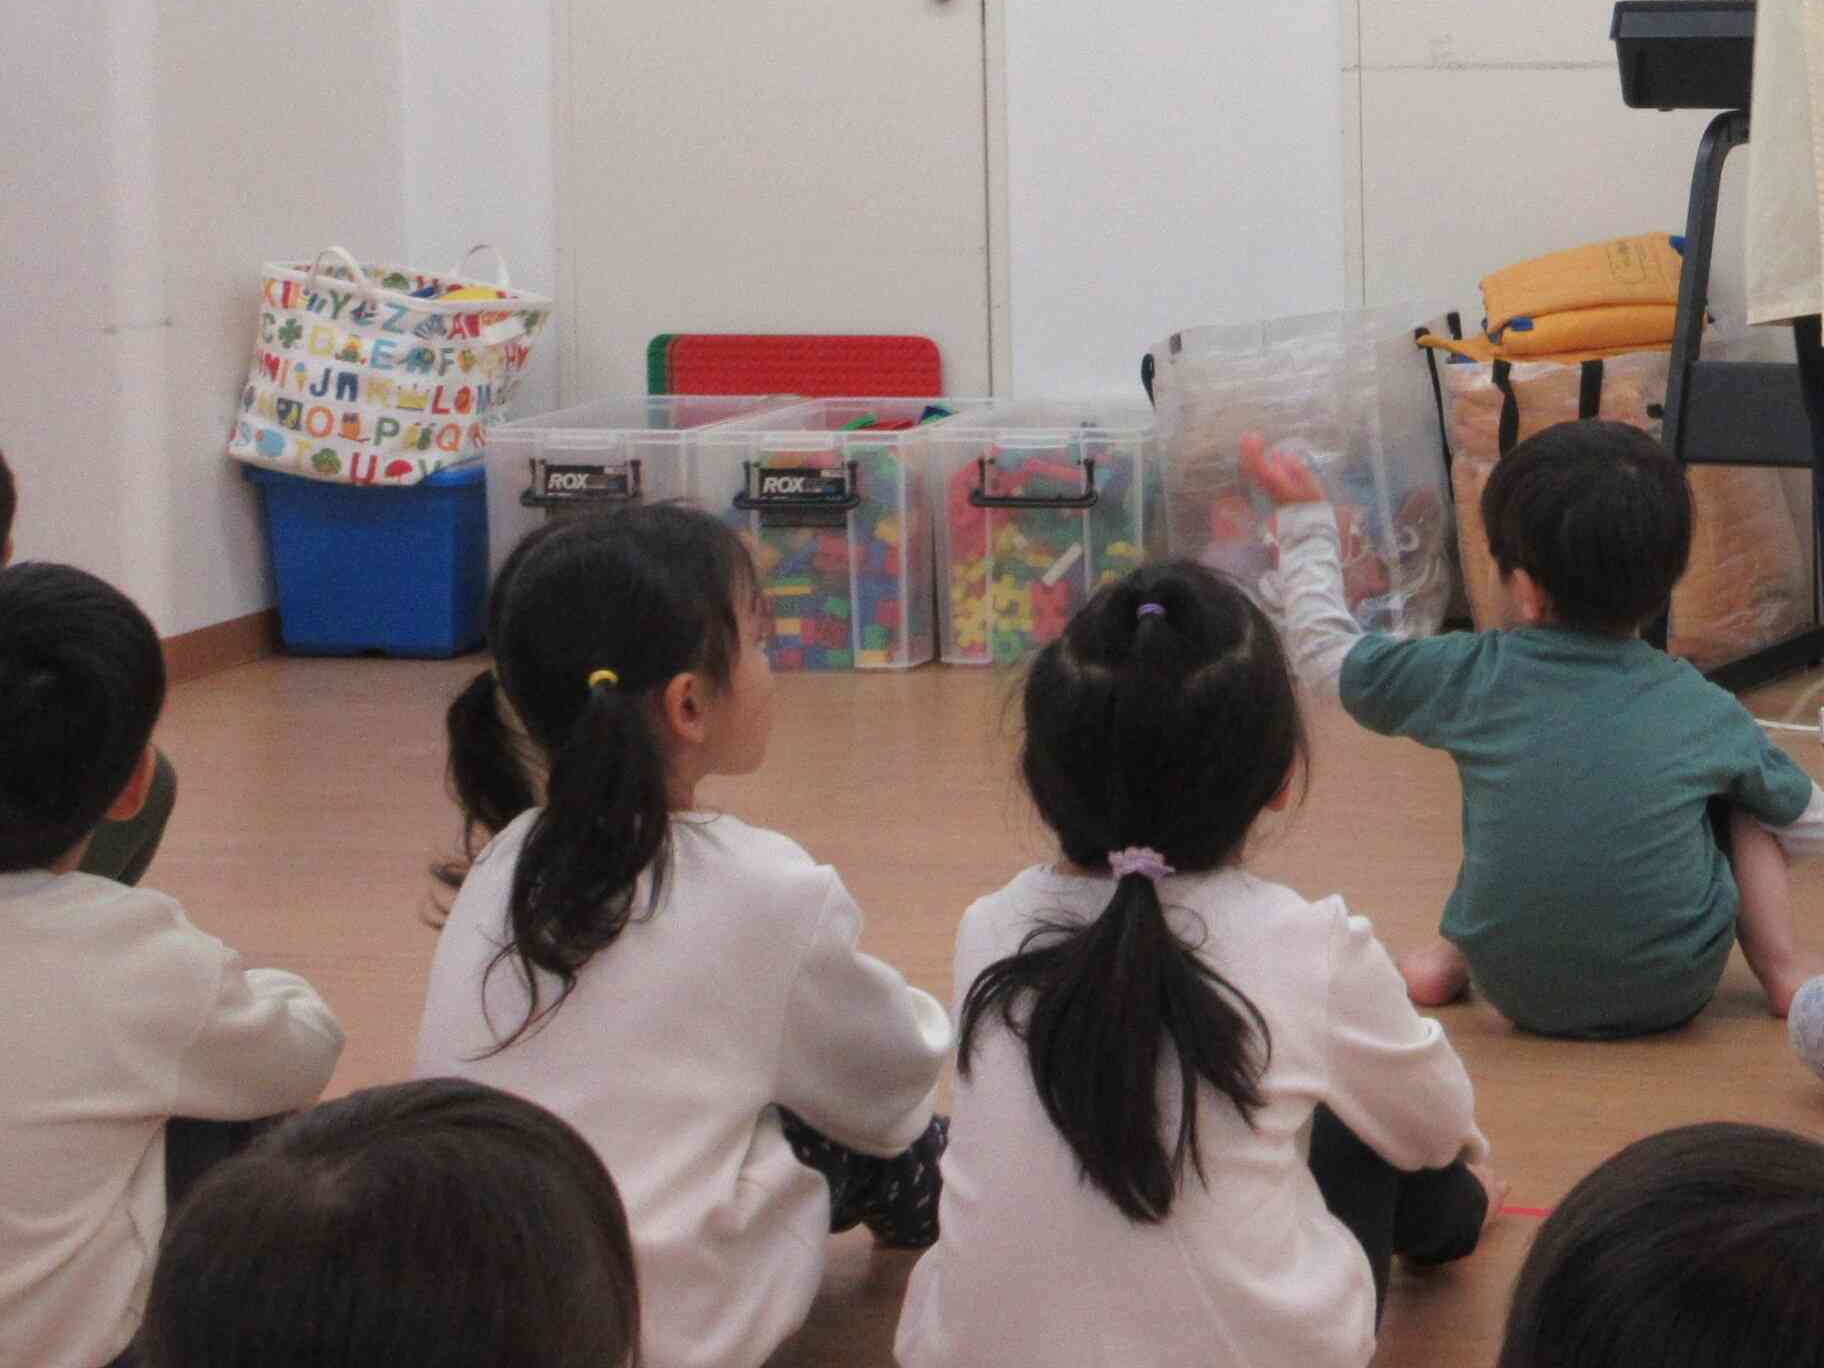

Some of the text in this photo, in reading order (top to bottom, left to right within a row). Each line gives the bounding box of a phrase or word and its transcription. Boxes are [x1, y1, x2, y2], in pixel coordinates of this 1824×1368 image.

[371, 338, 401, 369] E
[309, 368, 331, 397] J
[432, 385, 451, 414] L
[306, 406, 336, 438] O
[374, 416, 399, 446] P
[351, 452, 379, 484] U
[548, 473, 589, 490] ROX
[763, 476, 805, 493] ROX
